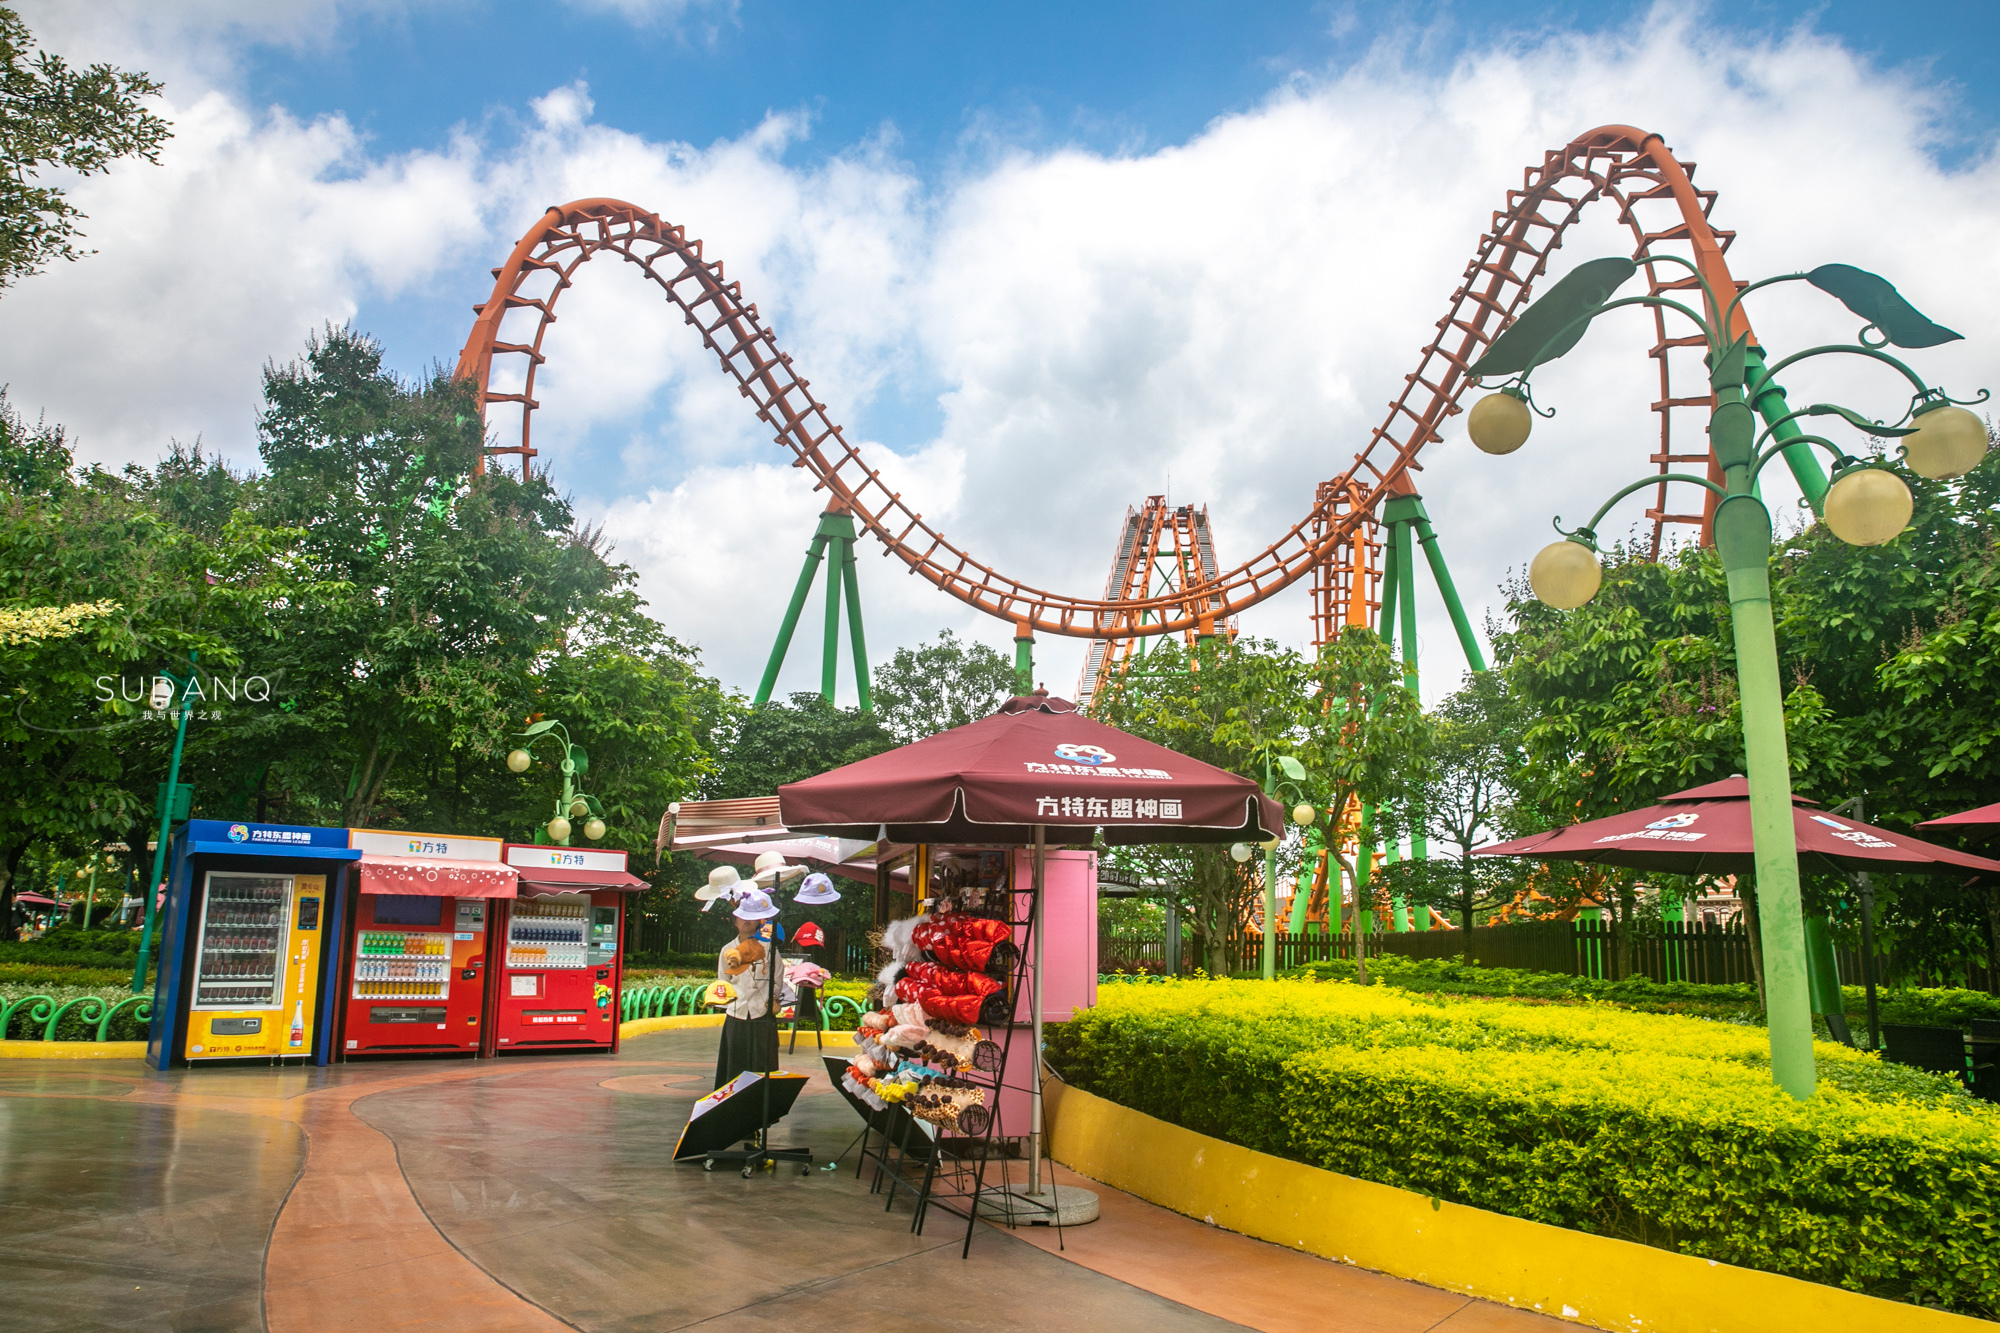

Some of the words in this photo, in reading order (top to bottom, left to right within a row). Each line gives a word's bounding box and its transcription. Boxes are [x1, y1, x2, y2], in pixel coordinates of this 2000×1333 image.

[1023, 762, 1170, 777] 方特东盟神画
[1036, 796, 1183, 819] 方特东盟神画
[252, 830, 311, 840] 方特东盟神画
[422, 842, 448, 854] 方特
[562, 854, 584, 865] 方特
